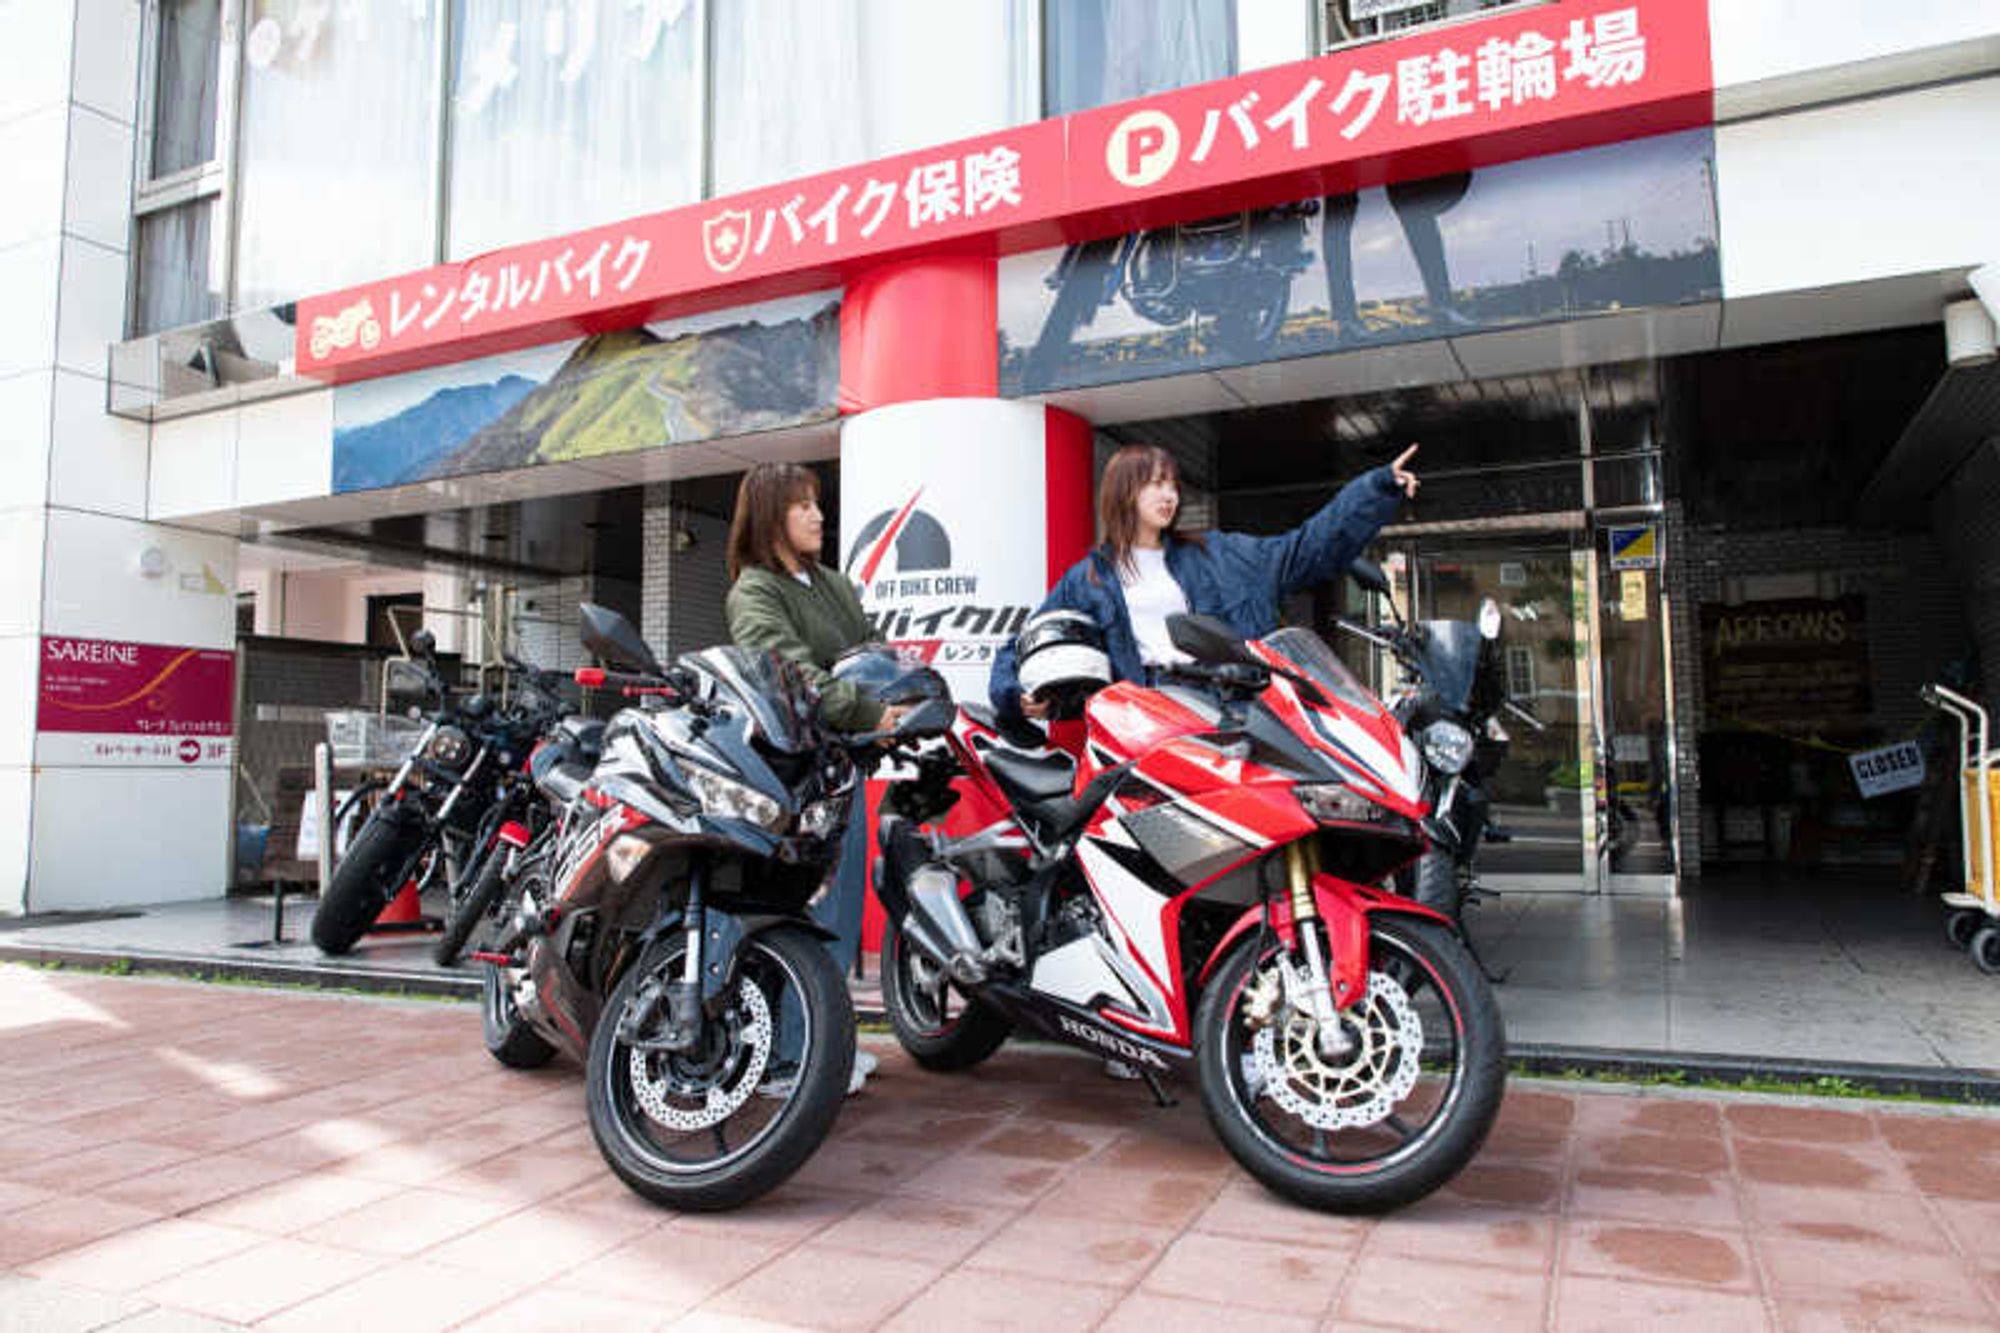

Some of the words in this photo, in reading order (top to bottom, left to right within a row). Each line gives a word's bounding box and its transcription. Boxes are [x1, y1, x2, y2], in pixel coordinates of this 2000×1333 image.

[1191, 7, 1647, 162] バイク駐輪場
[754, 146, 1022, 255] バイク保険
[389, 236, 651, 337] レンタルバイク
[875, 580, 897, 599] OFF
[900, 578, 932, 597] BIKE
[935, 574, 977, 595] CREW
[864, 604, 1032, 641] バイクル
[46, 639, 140, 667] SAREINE
[1855, 744, 1919, 780] CLOSED
[1059, 1013, 1170, 1071] HONDA
